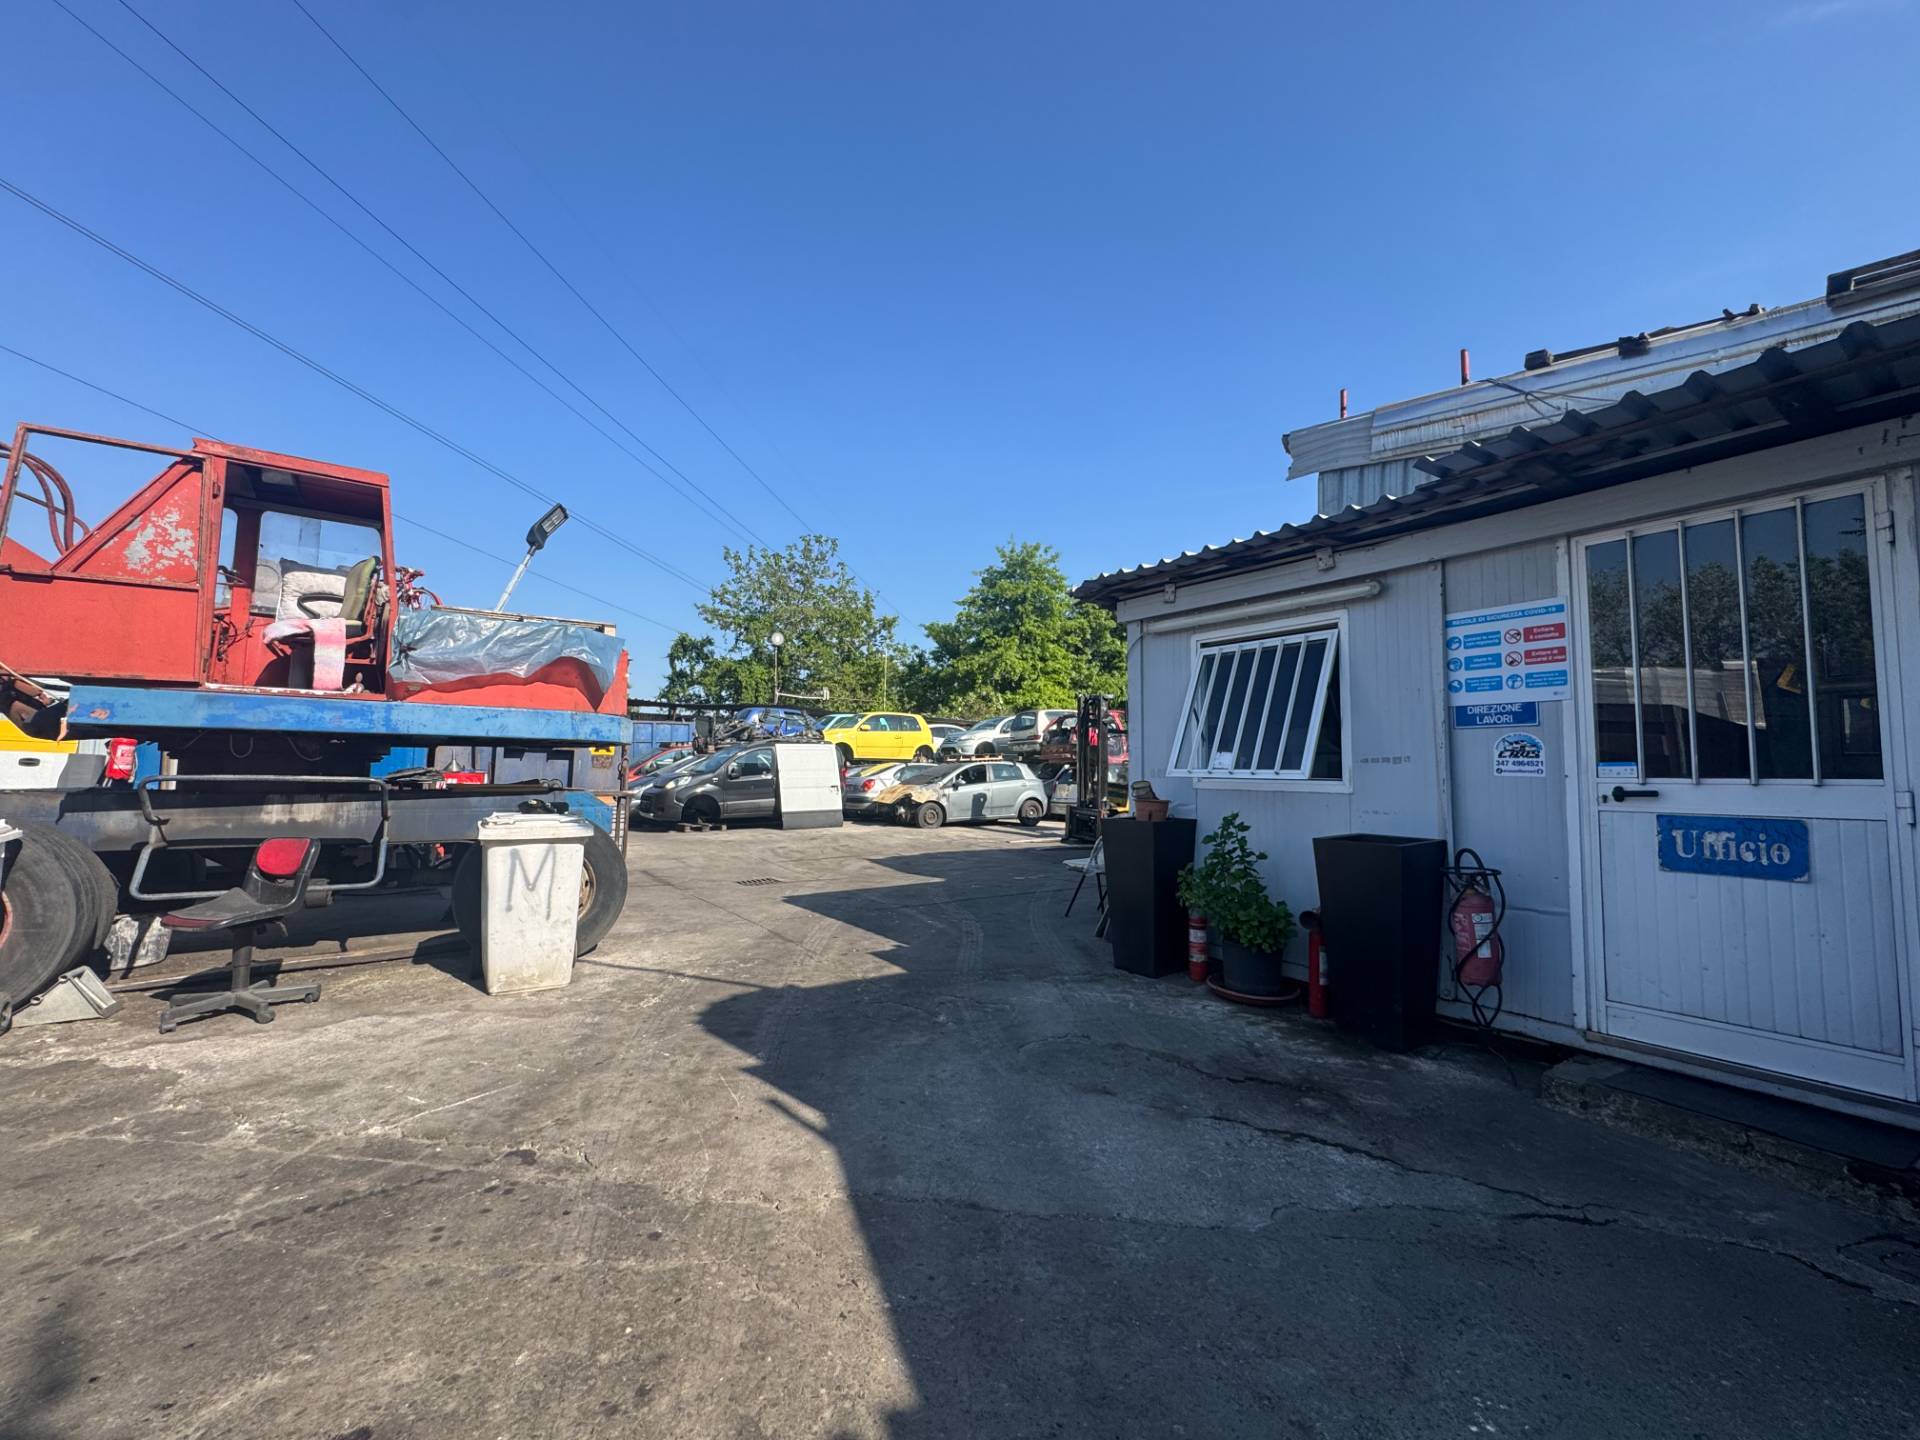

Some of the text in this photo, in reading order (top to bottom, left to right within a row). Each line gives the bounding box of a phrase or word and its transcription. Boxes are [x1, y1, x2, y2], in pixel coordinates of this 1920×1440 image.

[1452, 617, 1477, 625] REGOLE
[1486, 611, 1523, 621] SICUREZZA
[1523, 606, 1556, 616] COVID-19
[1467, 703, 1523, 715] DIREZIONE
[1476, 714, 1513, 725] LAVORI
[1671, 829, 1791, 866] Ufficio
[505, 843, 556, 921] M
